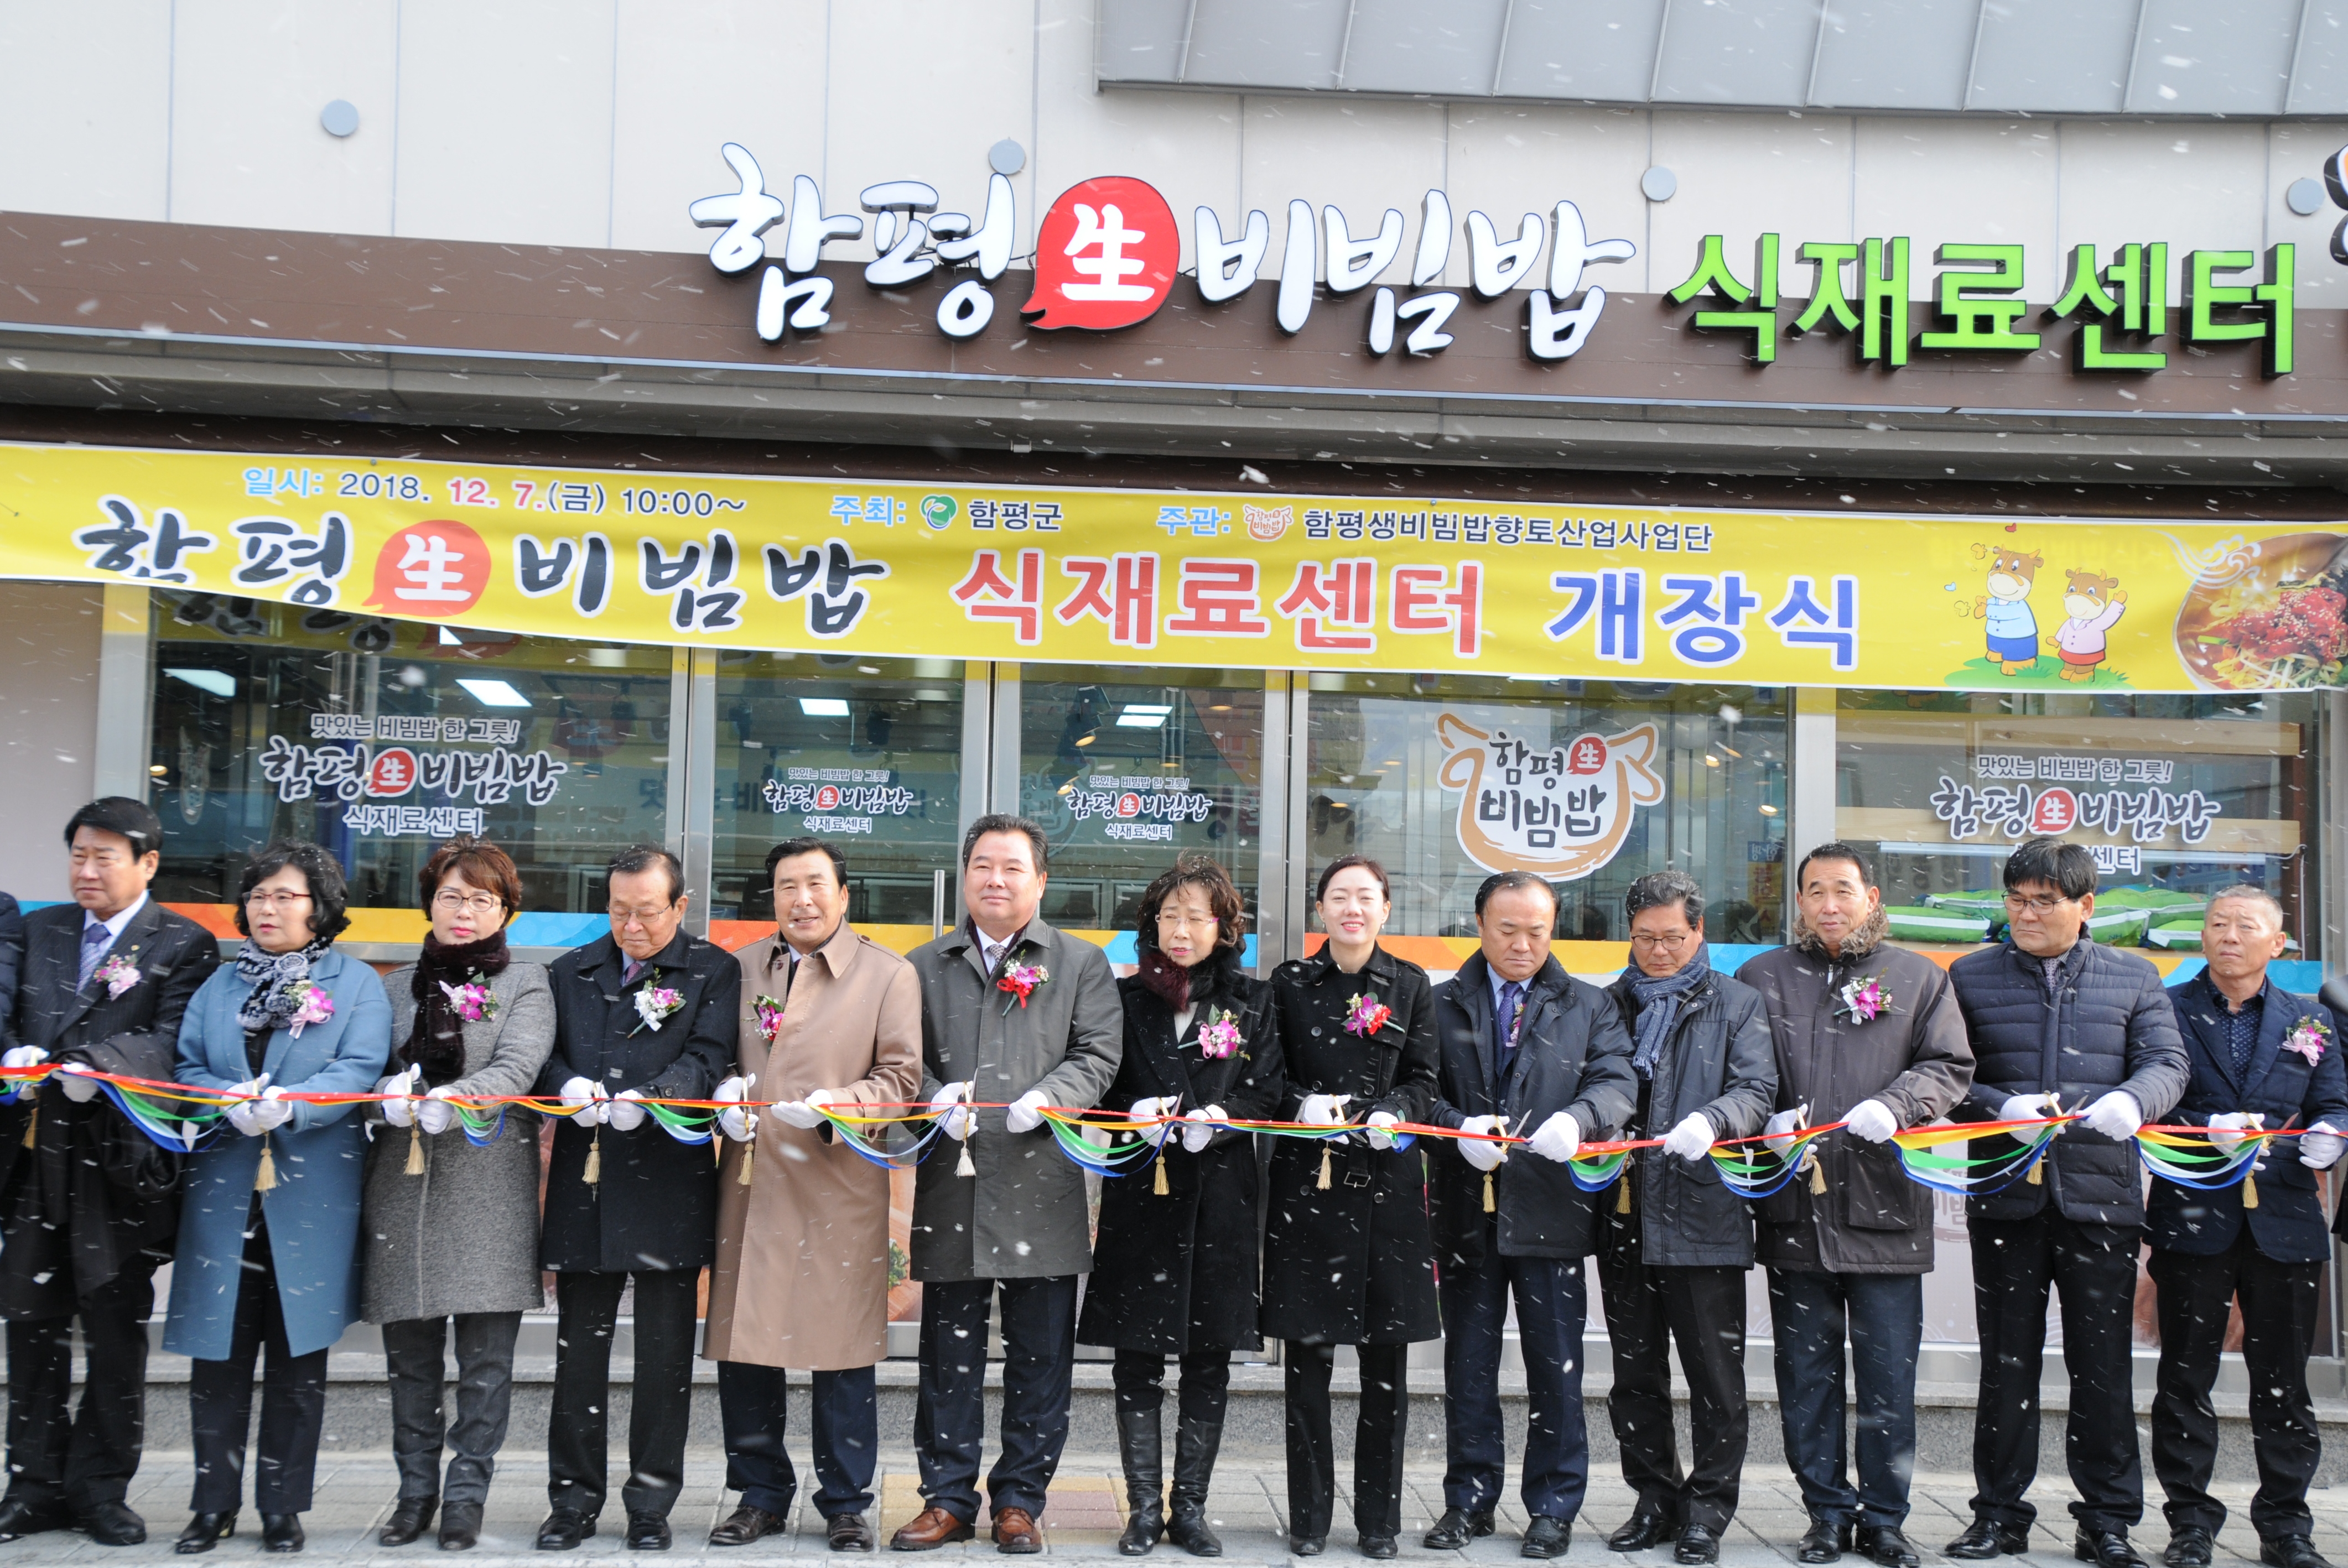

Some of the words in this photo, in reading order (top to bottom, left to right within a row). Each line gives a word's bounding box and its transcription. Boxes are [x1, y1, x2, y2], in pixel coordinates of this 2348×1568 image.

[1666, 232, 2295, 376] 식재료센터
[243, 468, 323, 497] 일시:
[340, 473, 430, 501] 2018.
[449, 479, 498, 506] 12.
[620, 489, 745, 516] 10:00~
[831, 496, 905, 525] 주최:
[969, 501, 1062, 532] 함평군
[1157, 507, 1230, 535] 주관:
[1303, 509, 1713, 551] 함평생비빔밥향토산업사업단
[954, 551, 1479, 655] 식재료센터
[1549, 571, 1854, 667] 개장식
[311, 713, 371, 738] 맛있는
[378, 716, 438, 741] 비빔밥
[444, 718, 466, 741] 한
[470, 720, 520, 743] 그릇!
[789, 768, 818, 779] 맛있는
[820, 769, 850, 780] 비빔밥
[852, 769, 863, 781] 한
[865, 769, 889, 782] 그릇!
[1090, 775, 1119, 788] 맛있는
[1121, 777, 1149, 788] 비빔밥
[1154, 777, 1163, 788] 한
[1165, 778, 1189, 789] 그릇!
[1977, 755, 2034, 779] 맛있는
[2039, 757, 2096, 780] 비빔밥
[2100, 758, 2121, 781] 한
[2125, 759, 2173, 783] 그릇!
[343, 805, 483, 837] 식재료센터
[804, 816, 871, 833] 식재료센터
[1479, 784, 1607, 848] 비빔밥
[1105, 824, 1172, 840] 식재료센터
